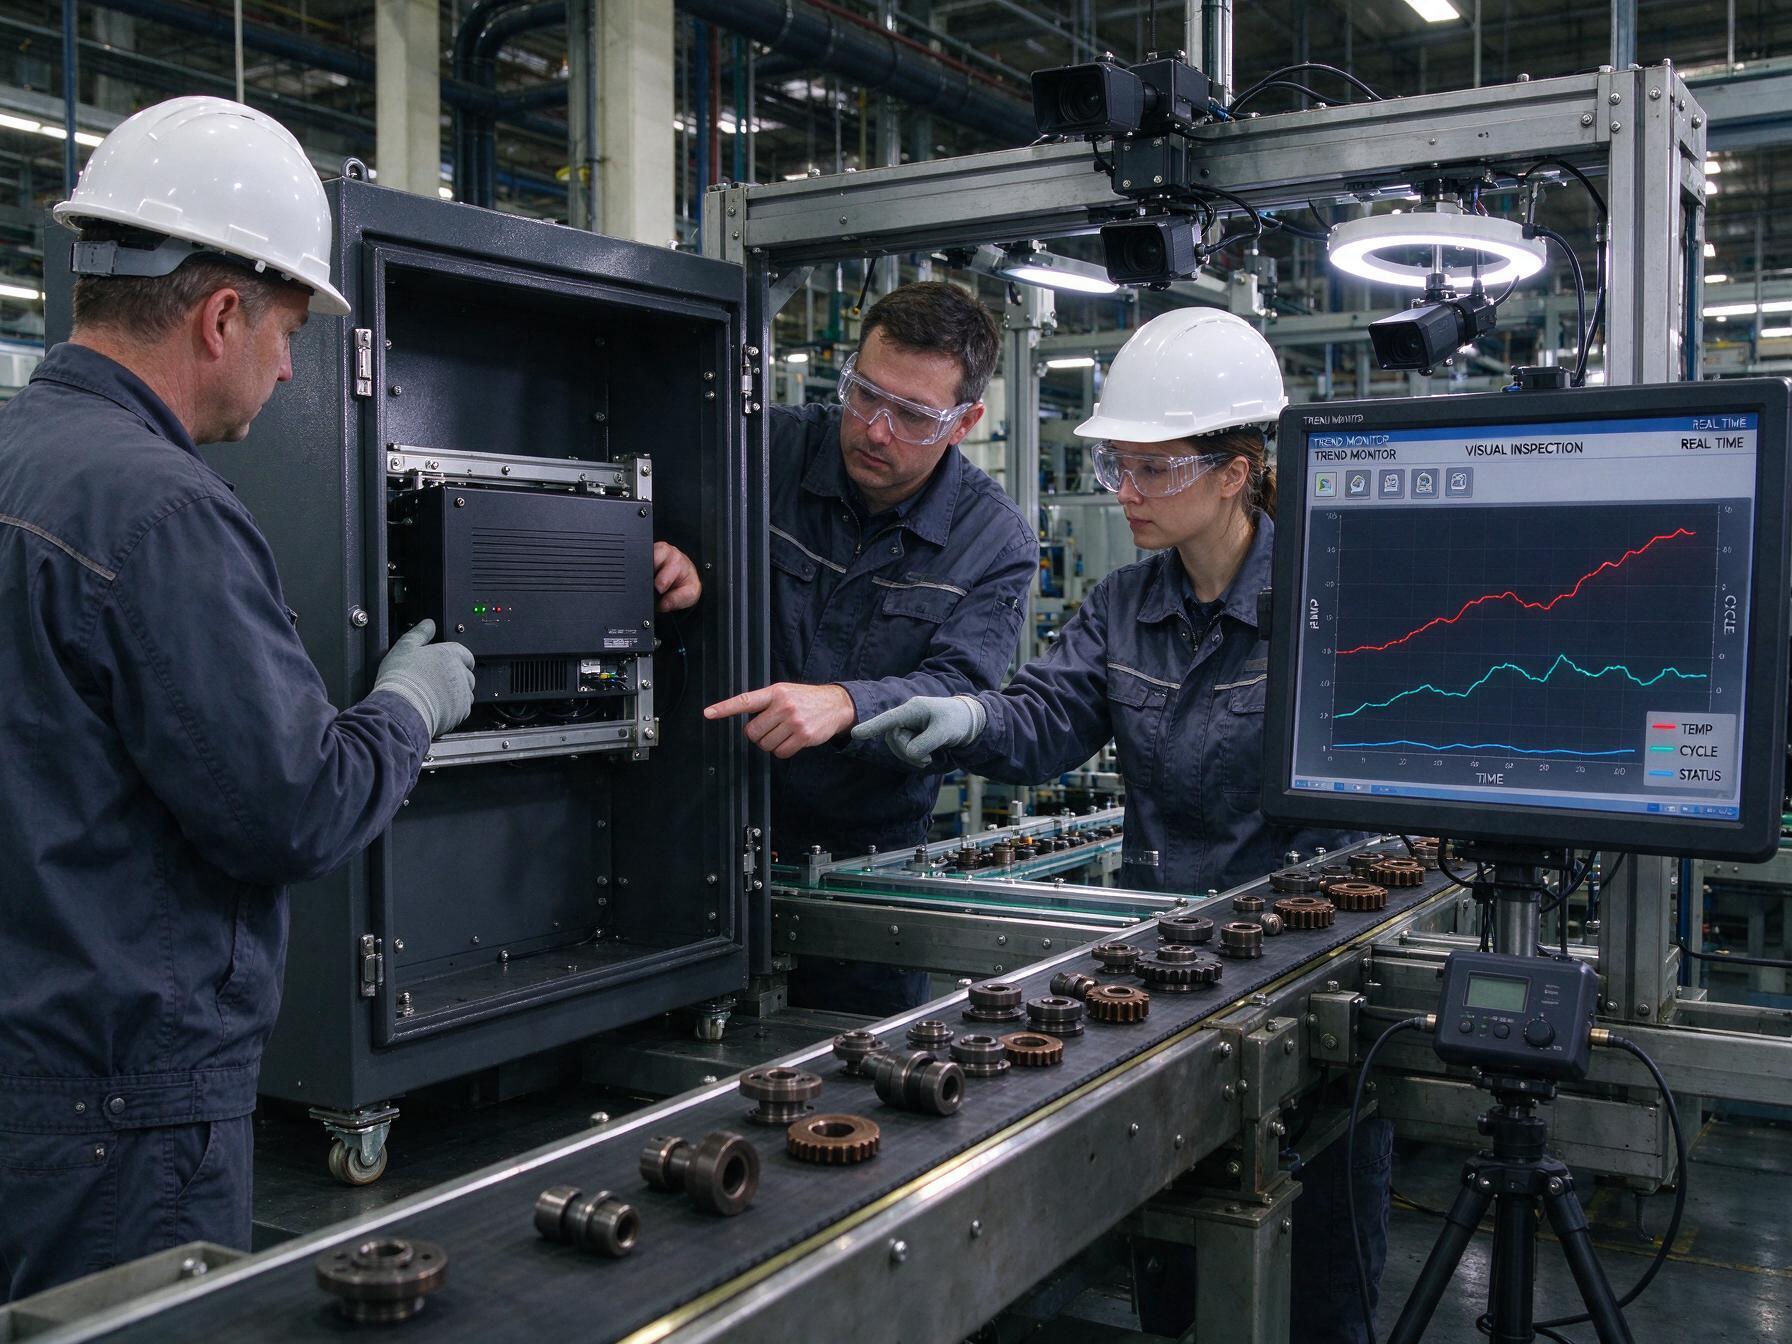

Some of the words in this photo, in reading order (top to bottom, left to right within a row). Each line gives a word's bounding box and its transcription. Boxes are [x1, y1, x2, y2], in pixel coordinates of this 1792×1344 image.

[1692, 417, 1720, 430] REAL
[1721, 417, 1747, 428] TIME
[1314, 437, 1343, 447] TREND
[1346, 434, 1390, 446] MONITOR
[1681, 437, 1711, 449] REAL
[1715, 436, 1745, 448] TIME
[1315, 449, 1347, 461] TREND
[1350, 448, 1397, 460] MONITOR
[1465, 444, 1507, 456] VISUAL
[1510, 441, 1584, 455] INSPECTION
[1681, 723, 1713, 735] TEMP
[1680, 745, 1719, 758] CYCLE
[1475, 772, 1504, 785] TIME
[1680, 768, 1722, 782] STATUS
